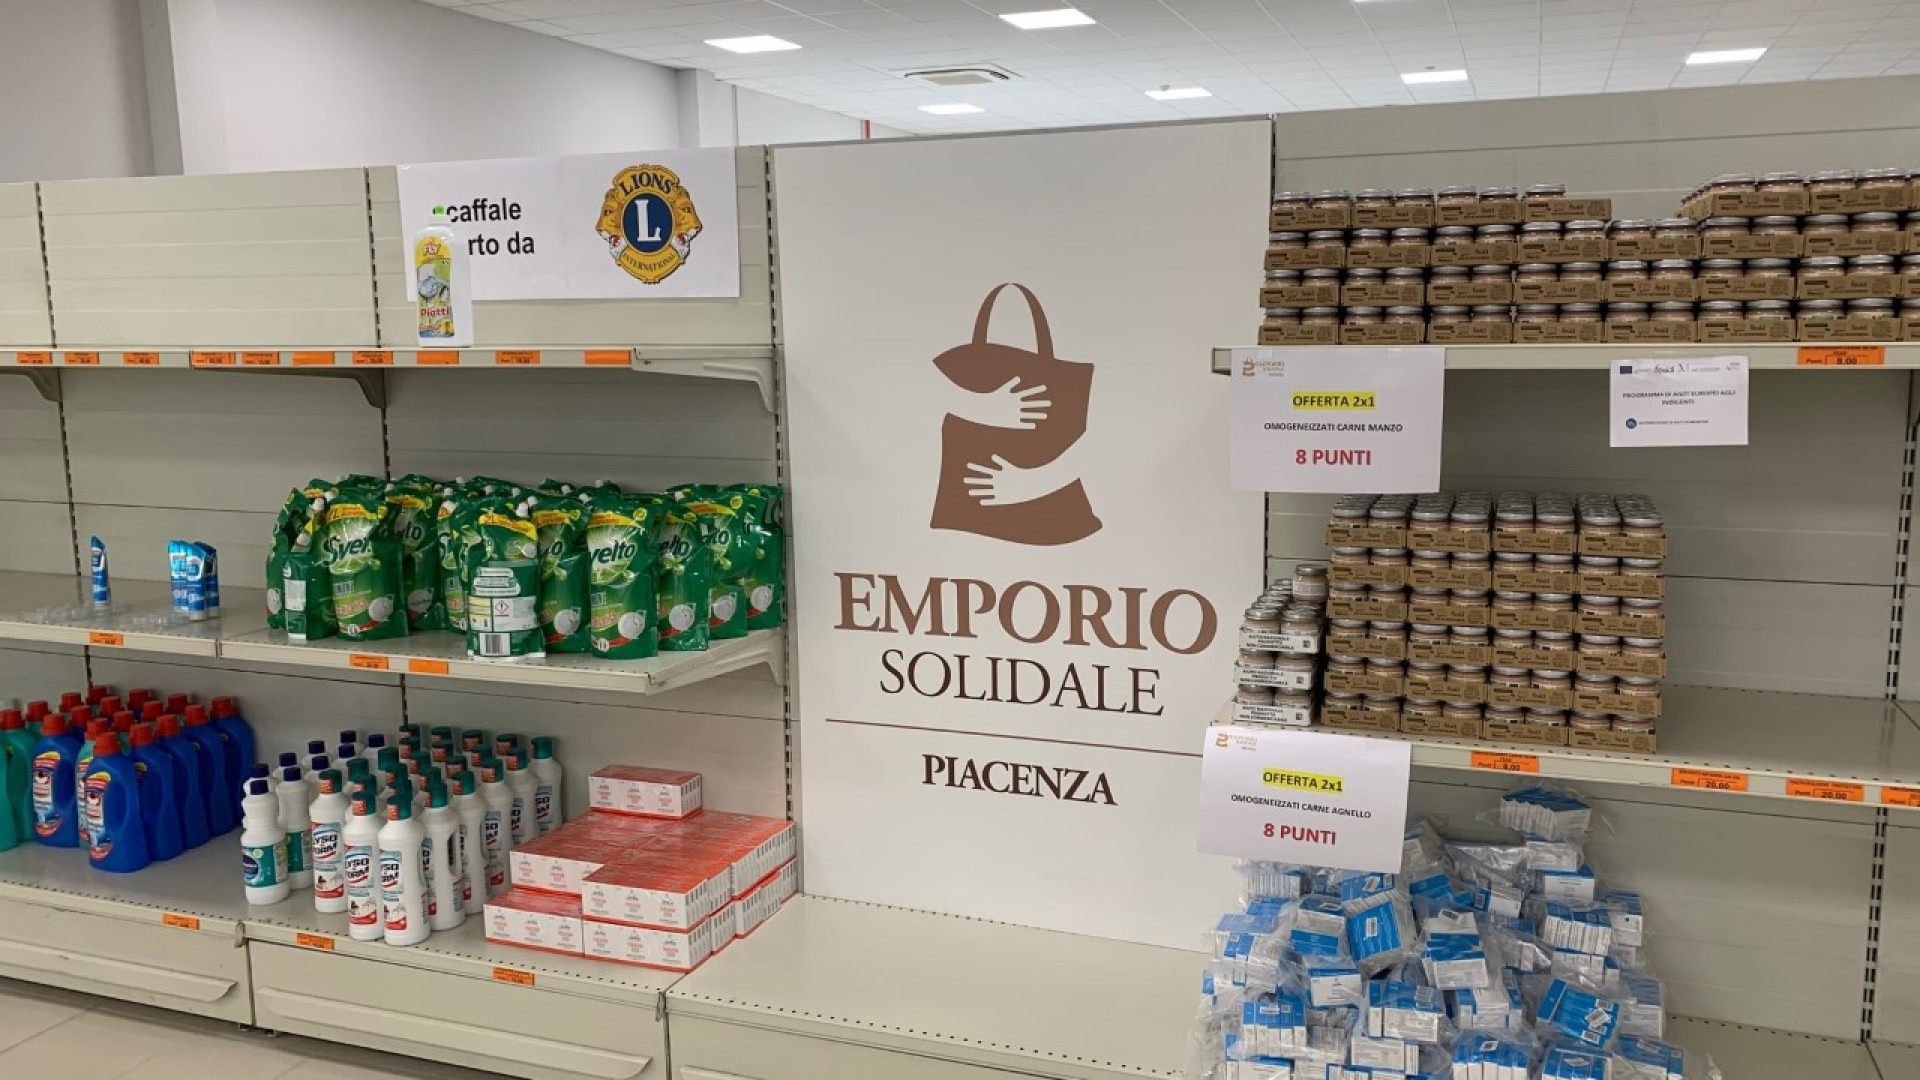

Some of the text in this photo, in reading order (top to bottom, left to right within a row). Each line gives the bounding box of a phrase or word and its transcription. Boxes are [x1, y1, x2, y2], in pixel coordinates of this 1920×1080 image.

[620, 171, 672, 196] LIONS
[447, 197, 521, 223] caffale
[634, 199, 662, 242] L
[507, 230, 535, 254] da
[1292, 395, 1375, 407] OFFERTA 2x1
[1264, 422, 1403, 433] OMOGENEIZZATI CARNE MANZO
[1295, 449, 1371, 465] 8 PUNTI
[833, 572, 1218, 655] EMPORIO
[879, 648, 1164, 716] SOLIDALE
[922, 754, 1118, 806] PIACENZA
[1263, 772, 1343, 792] OFFERTA 2x1
[1231, 794, 1371, 819] OMOGENEIZZATI CARNE AGNELLO
[1263, 823, 1336, 845] 8 PUNTI
